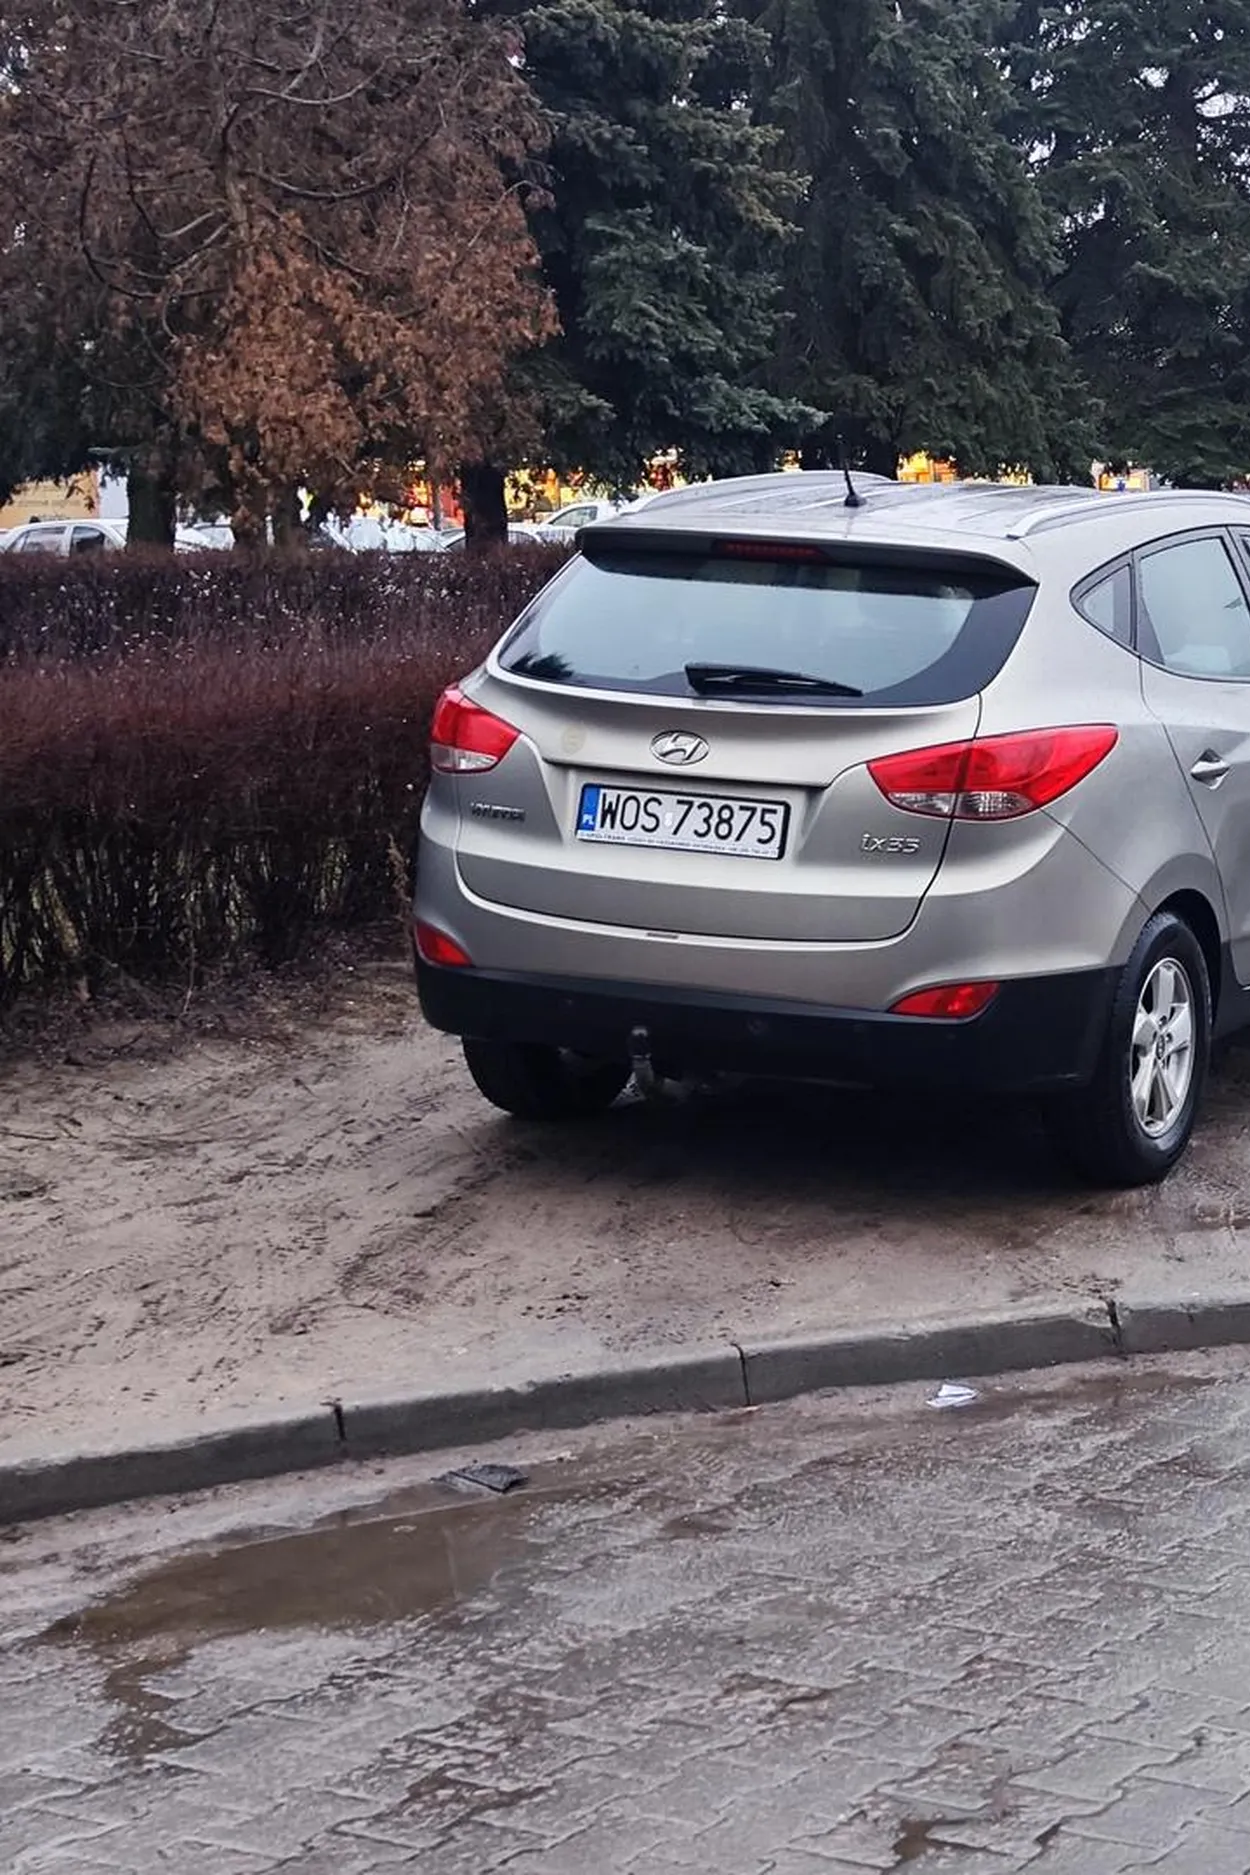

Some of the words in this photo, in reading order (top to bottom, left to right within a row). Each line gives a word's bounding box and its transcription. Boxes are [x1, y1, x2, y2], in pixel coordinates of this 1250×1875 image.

[582, 814, 594, 825] PL
[600, 792, 663, 833] WOS
[672, 799, 778, 845] 73875
